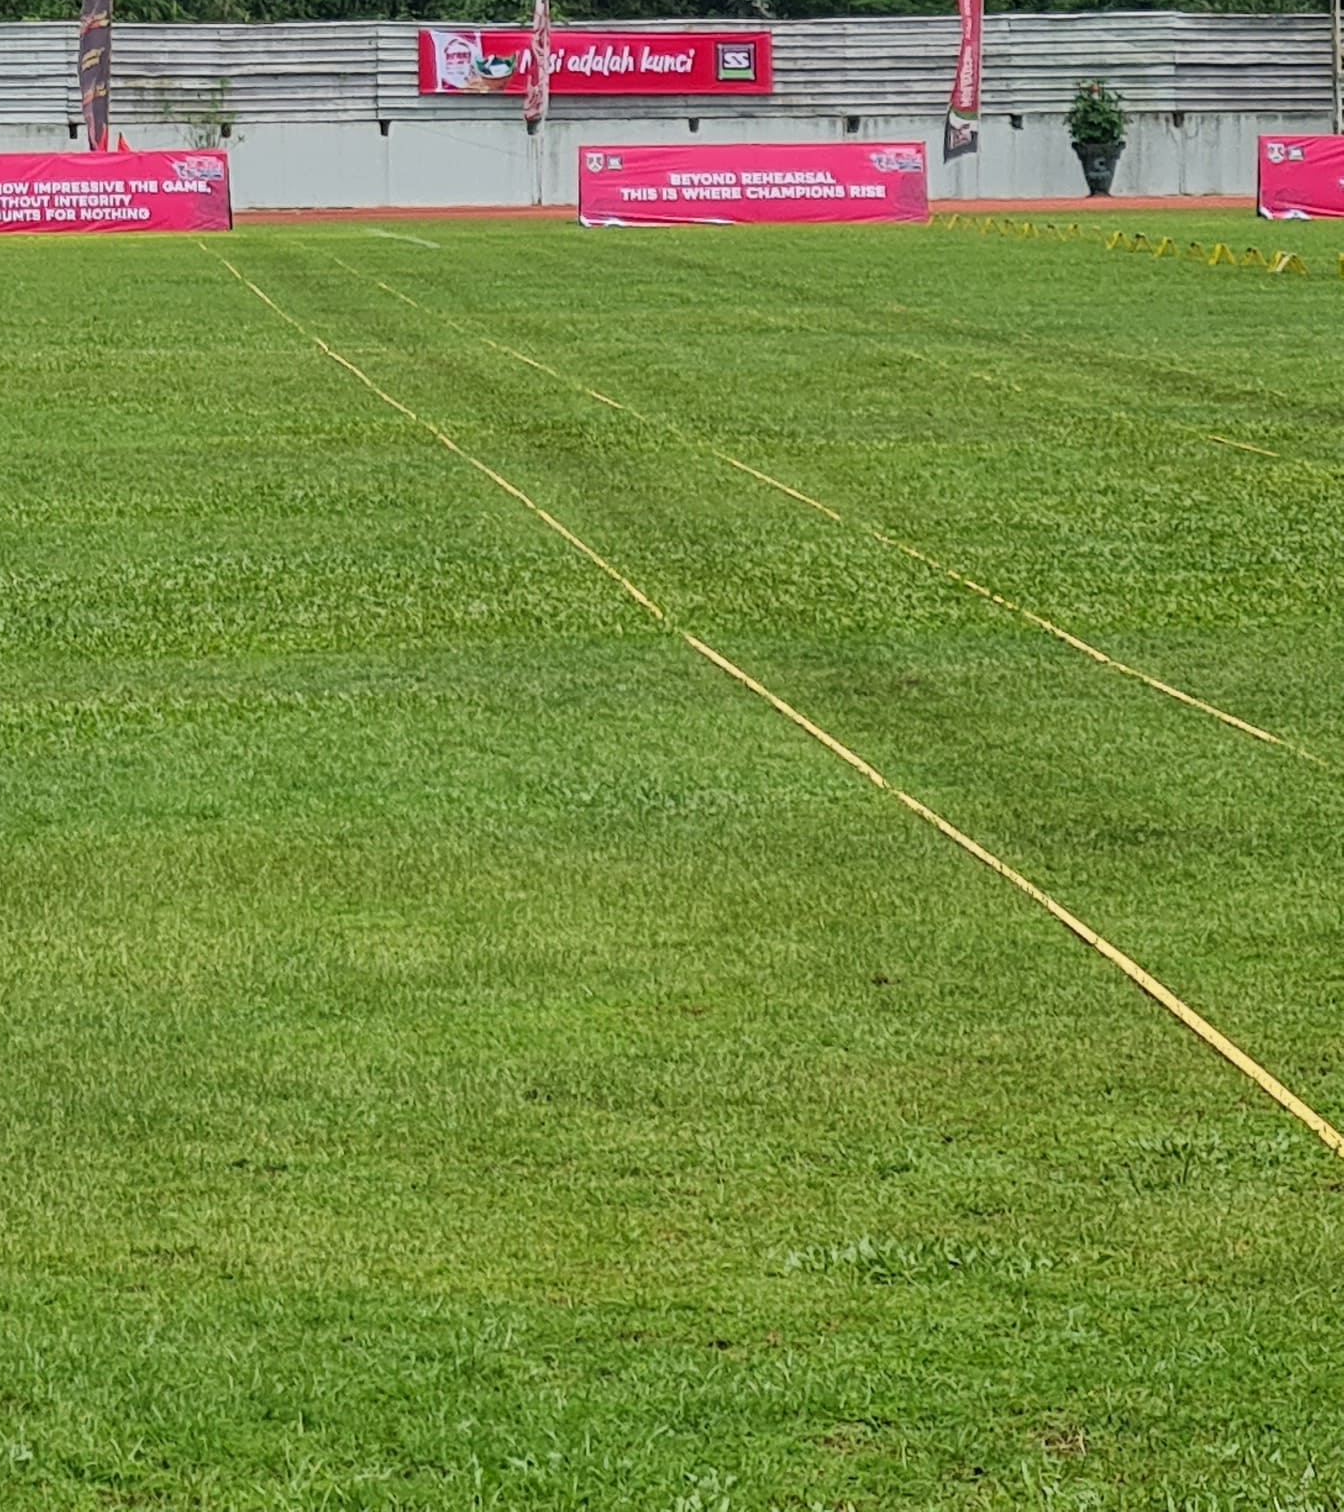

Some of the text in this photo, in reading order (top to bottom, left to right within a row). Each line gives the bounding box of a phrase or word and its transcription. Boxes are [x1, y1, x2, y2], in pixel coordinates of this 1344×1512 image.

[567, 46, 634, 76] adalah
[640, 46, 695, 73] kunci
[670, 172, 836, 186] BEYOND REHEARSAL
[34, 181, 125, 194] IMPRESSIVE
[129, 181, 158, 193] THE
[621, 185, 886, 201] THIS IS WHERE CHAMPIONS RISE
[54, 194, 132, 207] INTEGRITY
[46, 208, 76, 221] FOR
[81, 207, 150, 220] NOTHING
